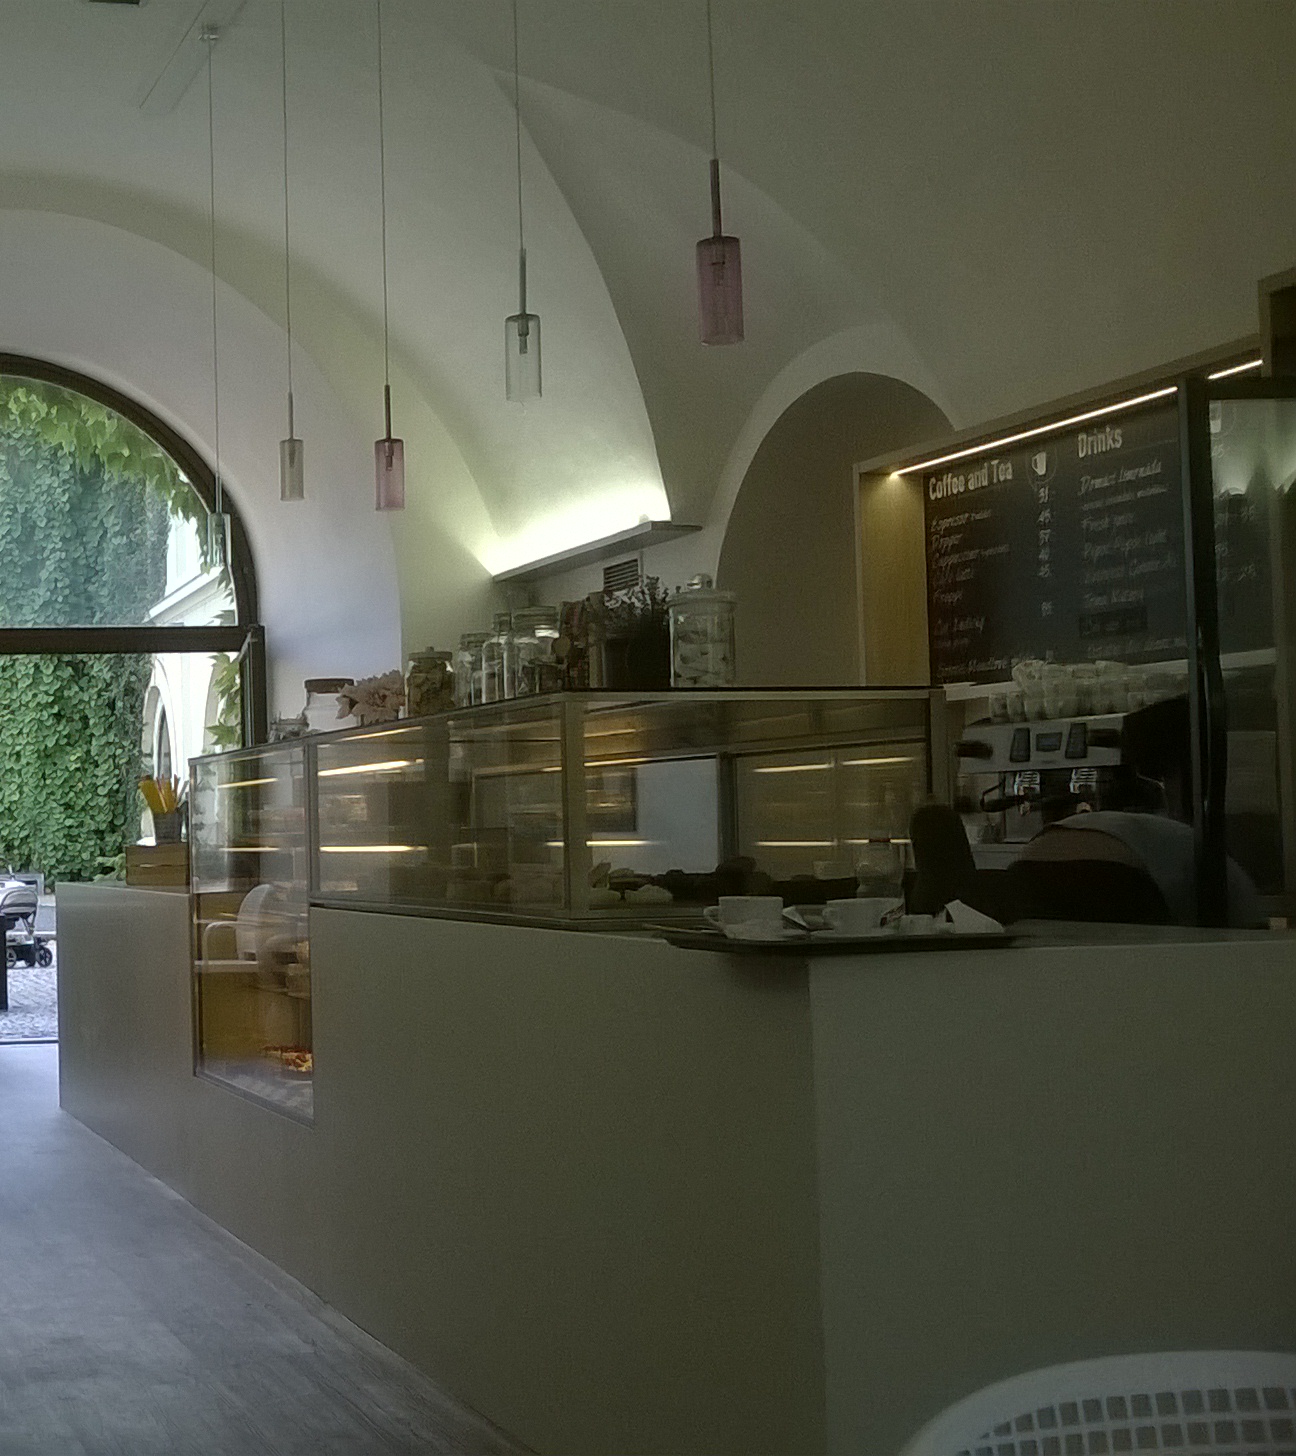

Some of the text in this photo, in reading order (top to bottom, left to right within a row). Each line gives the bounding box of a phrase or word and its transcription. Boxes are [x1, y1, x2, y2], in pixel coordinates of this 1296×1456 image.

[1077, 426, 1123, 458] Drinks
[929, 459, 1013, 501] Coffee and Tea
